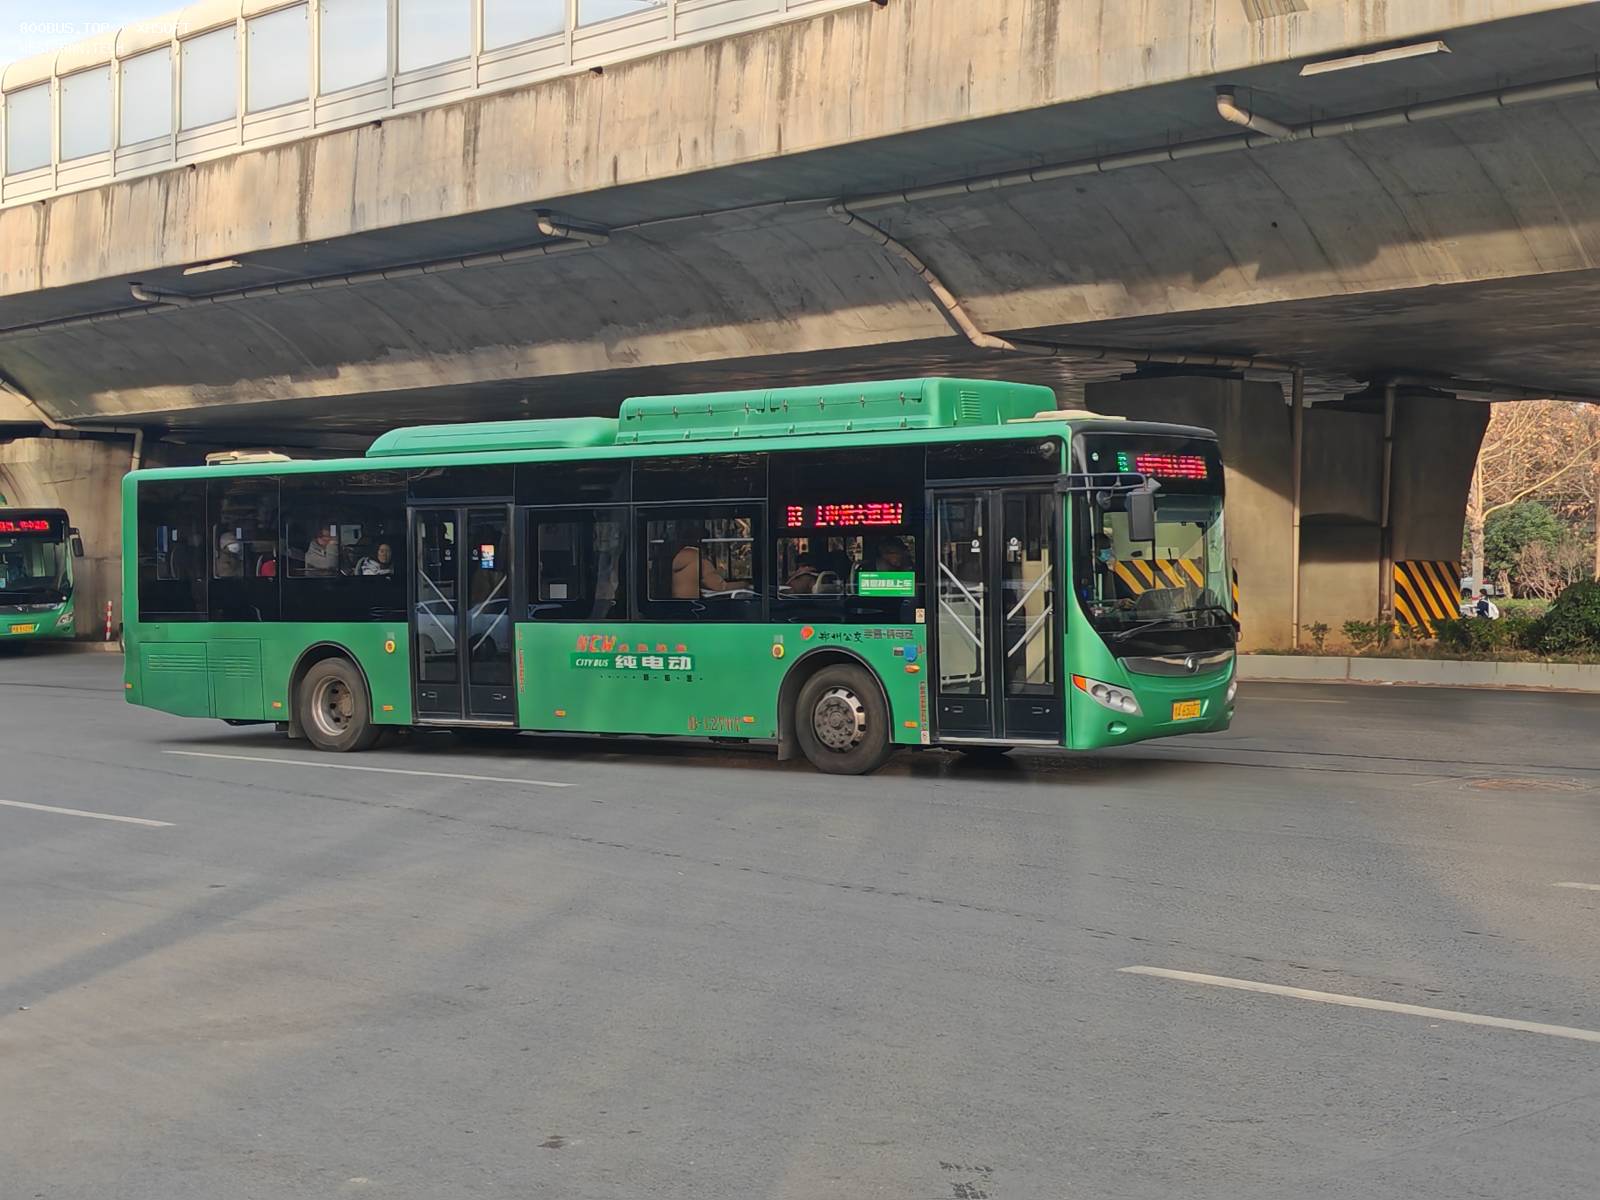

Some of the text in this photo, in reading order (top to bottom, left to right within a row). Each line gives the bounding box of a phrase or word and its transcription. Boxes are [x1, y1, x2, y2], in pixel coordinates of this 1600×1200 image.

[818, 631, 864, 643] 郑州公交
[575, 658, 609, 668] CITY BUS
[615, 655, 692, 670] 纯电动
